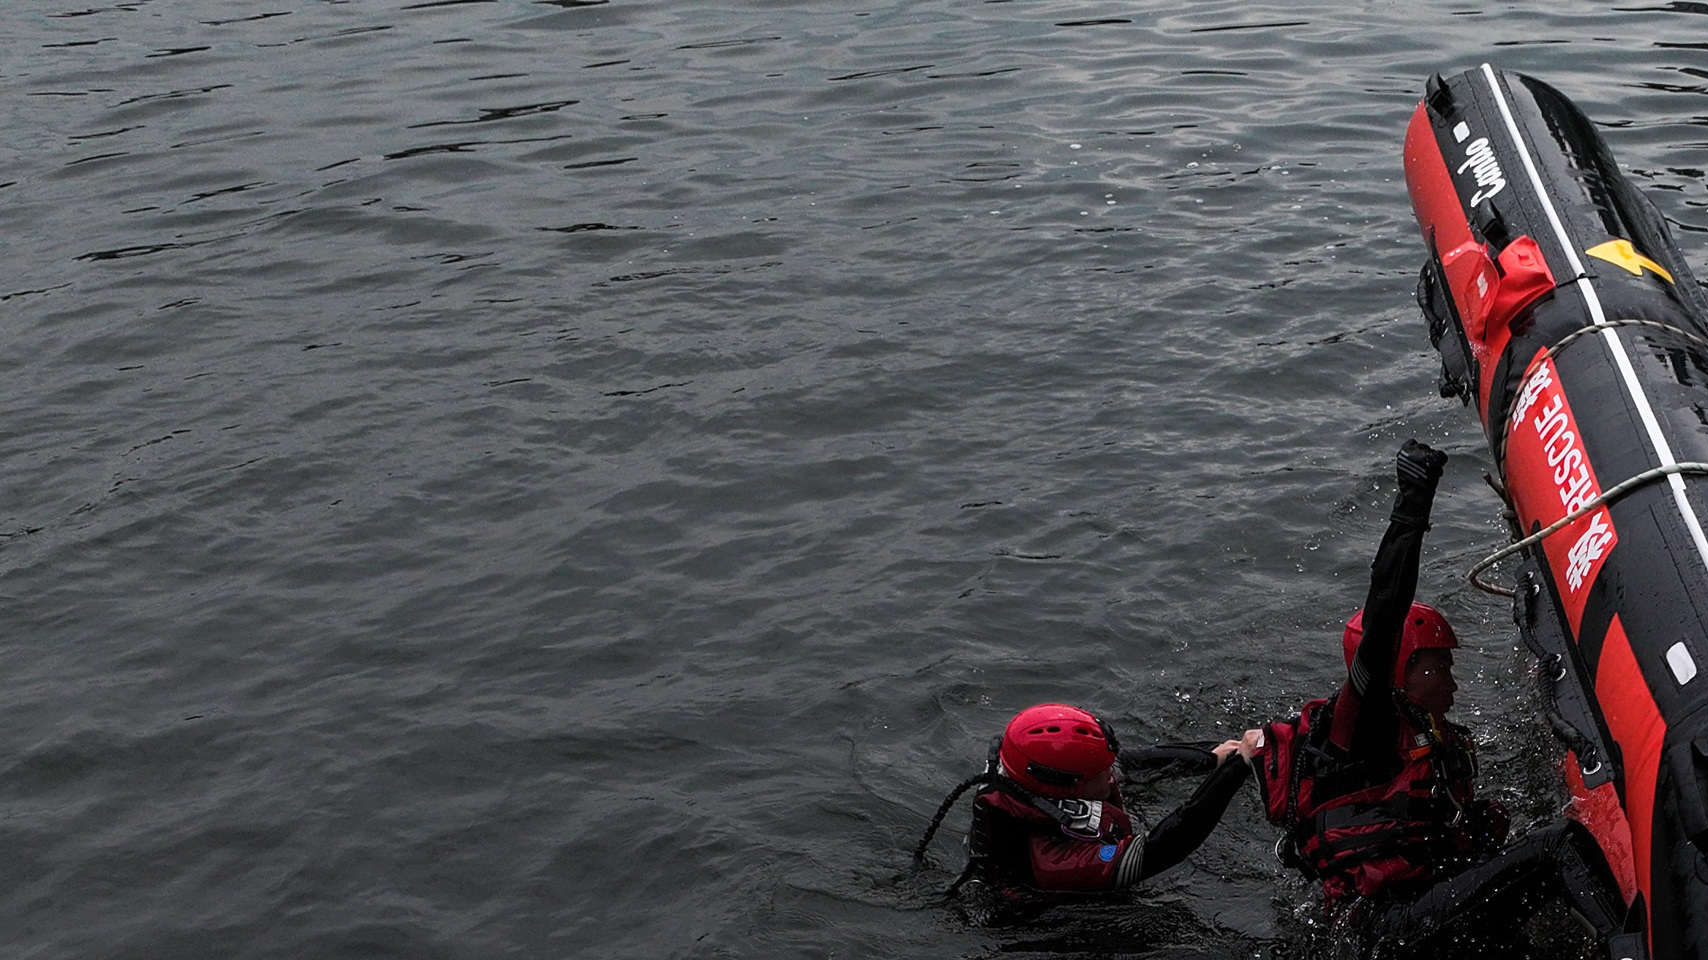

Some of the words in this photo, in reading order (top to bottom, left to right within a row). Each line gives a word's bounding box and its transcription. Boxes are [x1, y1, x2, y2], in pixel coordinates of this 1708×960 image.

[1457, 138, 1506, 207] Cando
[1534, 394, 1598, 525] RESCUE
[1566, 511, 1613, 592] 救
